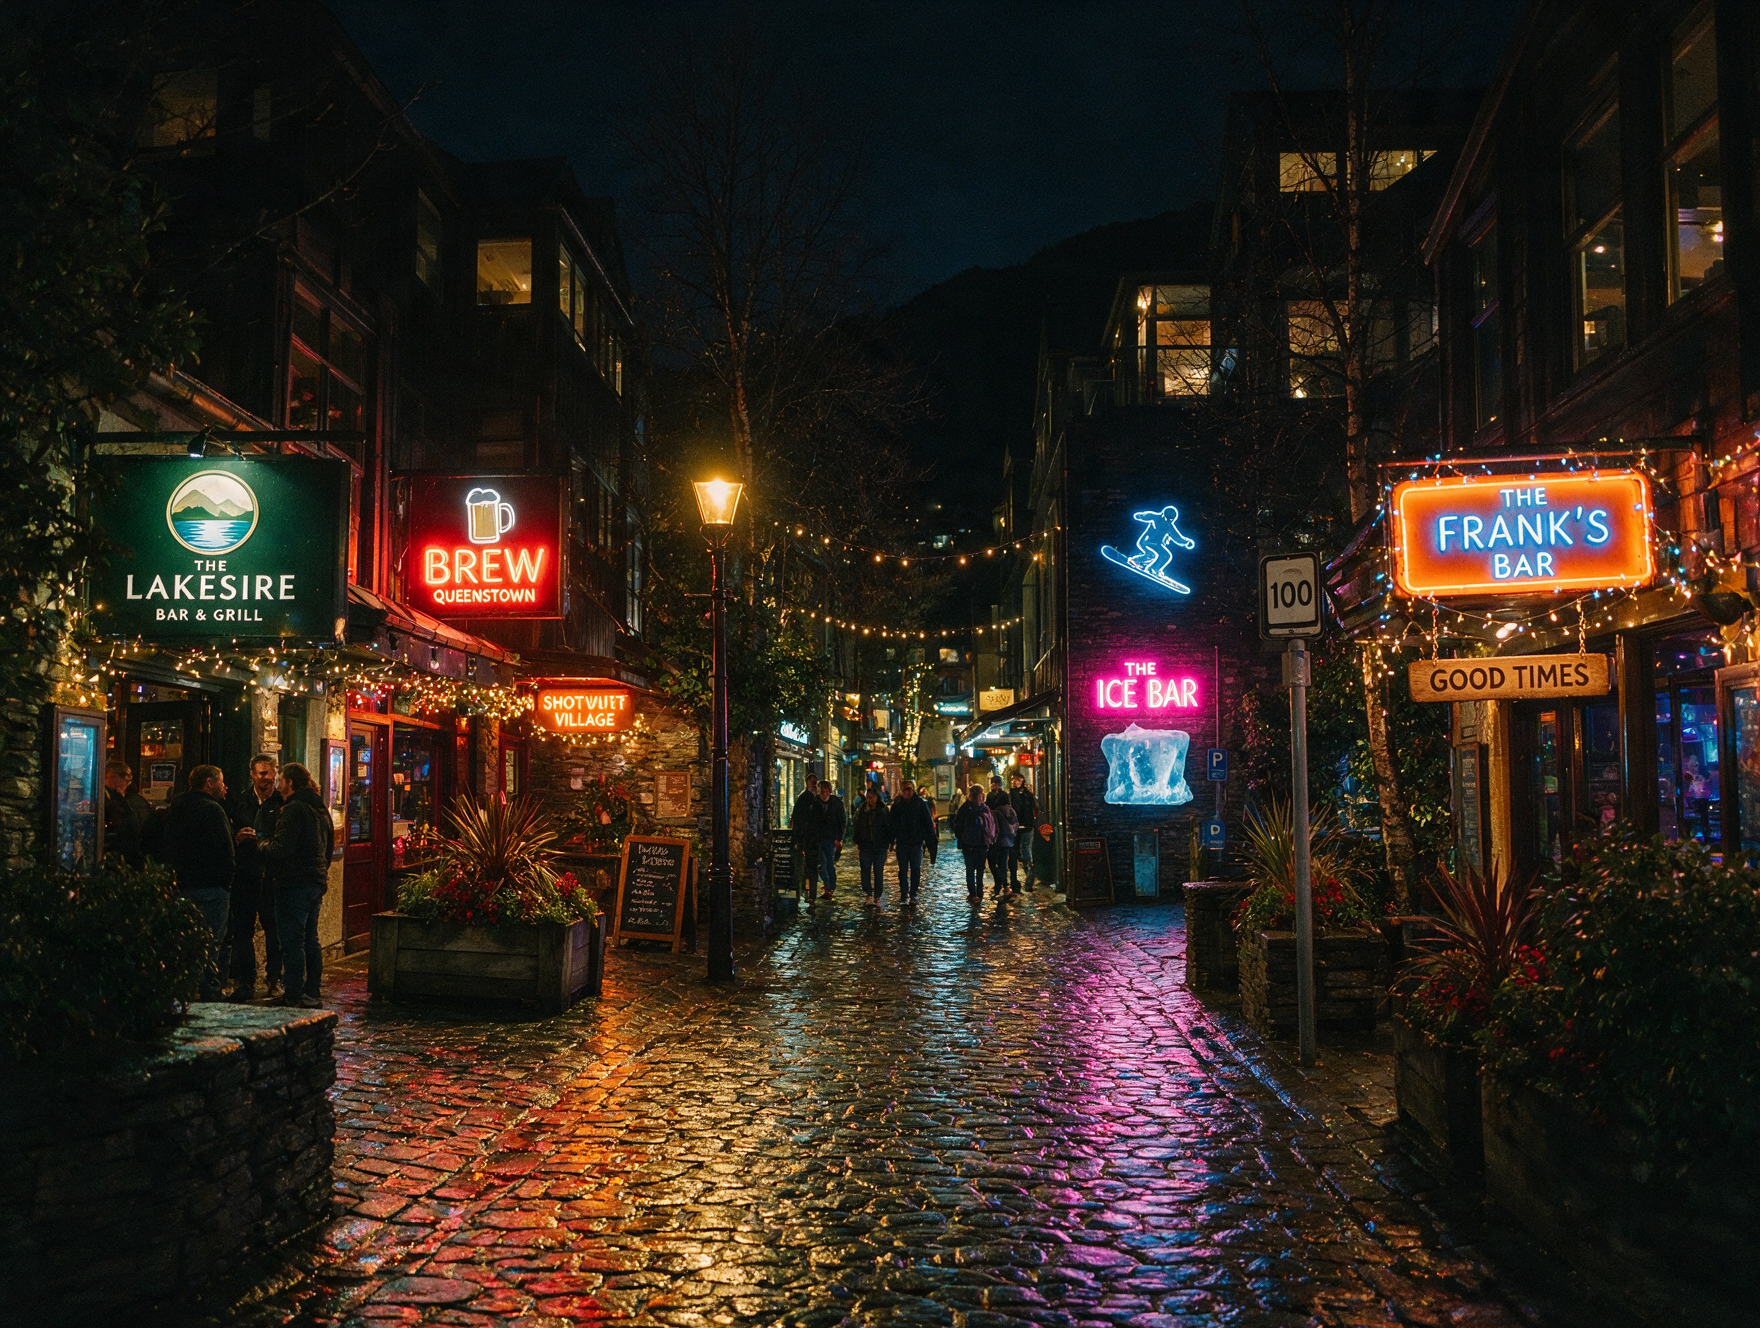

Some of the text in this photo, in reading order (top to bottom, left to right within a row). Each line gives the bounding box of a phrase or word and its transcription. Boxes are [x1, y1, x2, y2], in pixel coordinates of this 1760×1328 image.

[1500, 487, 1547, 507] THE
[1438, 506, 1609, 551] FRANK'S
[194, 560, 227, 572] THE
[424, 548, 544, 585] BREW
[1494, 552, 1554, 579] BAR
[126, 574, 296, 600] LAKESIRE
[433, 588, 536, 606] QUEENSTOWN
[1270, 580, 1312, 609] 100
[155, 608, 263, 621] BAR & GRILL
[1124, 662, 1156, 676] THE
[1430, 662, 1590, 691] GOOD TIMES
[1096, 679, 1198, 709] ICE BAR
[555, 712, 615, 727] VILLAGE
[1212, 752, 1223, 767] P
